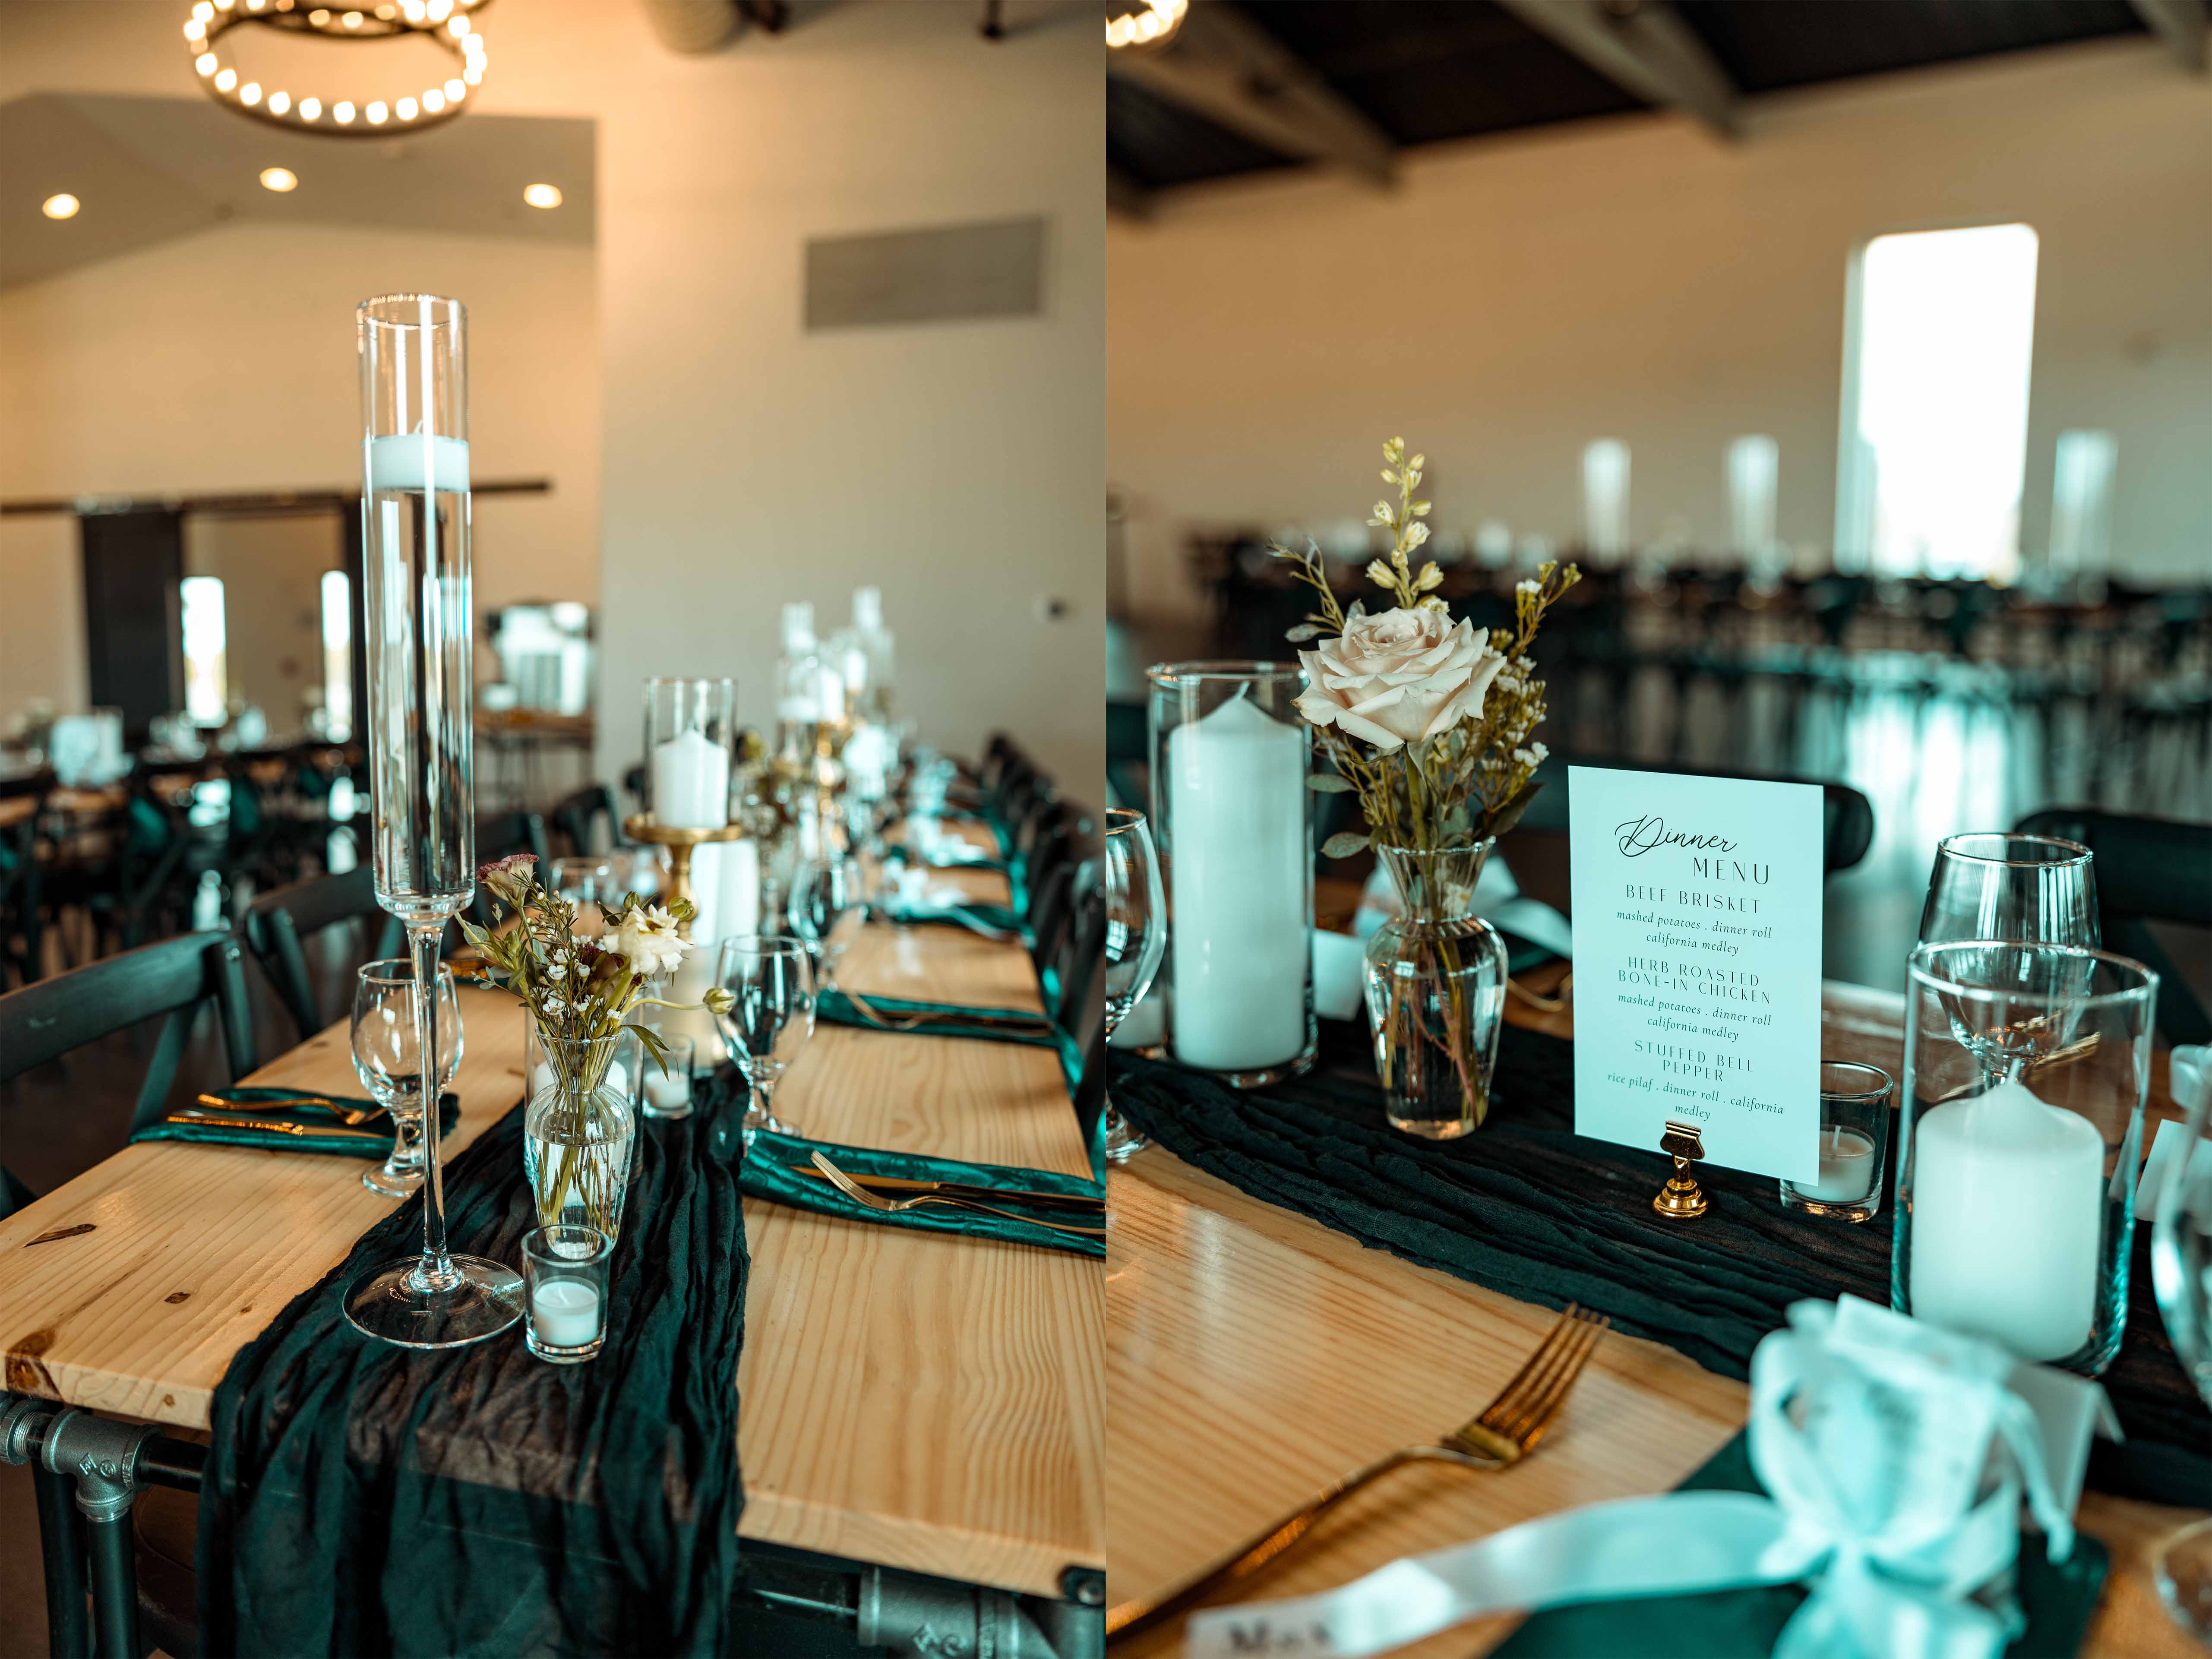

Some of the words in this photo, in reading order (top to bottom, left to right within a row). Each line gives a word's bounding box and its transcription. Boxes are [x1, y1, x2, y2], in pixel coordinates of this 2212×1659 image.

[1614, 814, 1738, 857] Dinner
[1694, 857, 1769, 885] MENU
[1627, 884, 1667, 902] BEEF
[1680, 891, 1761, 913] BRISKET
[1617, 910, 1654, 923] mashed
[1657, 916, 1700, 929] potatoes
[1712, 920, 1748, 935] dinner
[1752, 926, 1772, 939] roll
[1646, 932, 1697, 948] california
[1702, 940, 1738, 957] medley
[1629, 956, 1668, 973] HERB
[1680, 964, 1759, 986] ROASTED
[1619, 969, 1687, 991] BONE-IN
[1699, 982, 1770, 1004] CHICKEN
[1618, 994, 1655, 1007] mashed
[1658, 1001, 1701, 1014] potatoes
[1713, 1006, 1748, 1022] dinner
[1752, 1014, 1771, 1026] roll
[1647, 1015, 1698, 1033] california
[1702, 1026, 1739, 1043] medley
[1634, 1040, 1706, 1063] STUFFED
[1716, 1054, 1754, 1072] BELL
[1663, 1059, 1723, 1082] PEPPER
[1608, 1072, 1626, 1084] rice
[1629, 1076, 1654, 1092] pilaf
[1663, 1081, 1697, 1097] dinner
[1701, 1090, 1719, 1102] roll
[1730, 1096, 1784, 1114] california
[1675, 1105, 1710, 1122] medley
